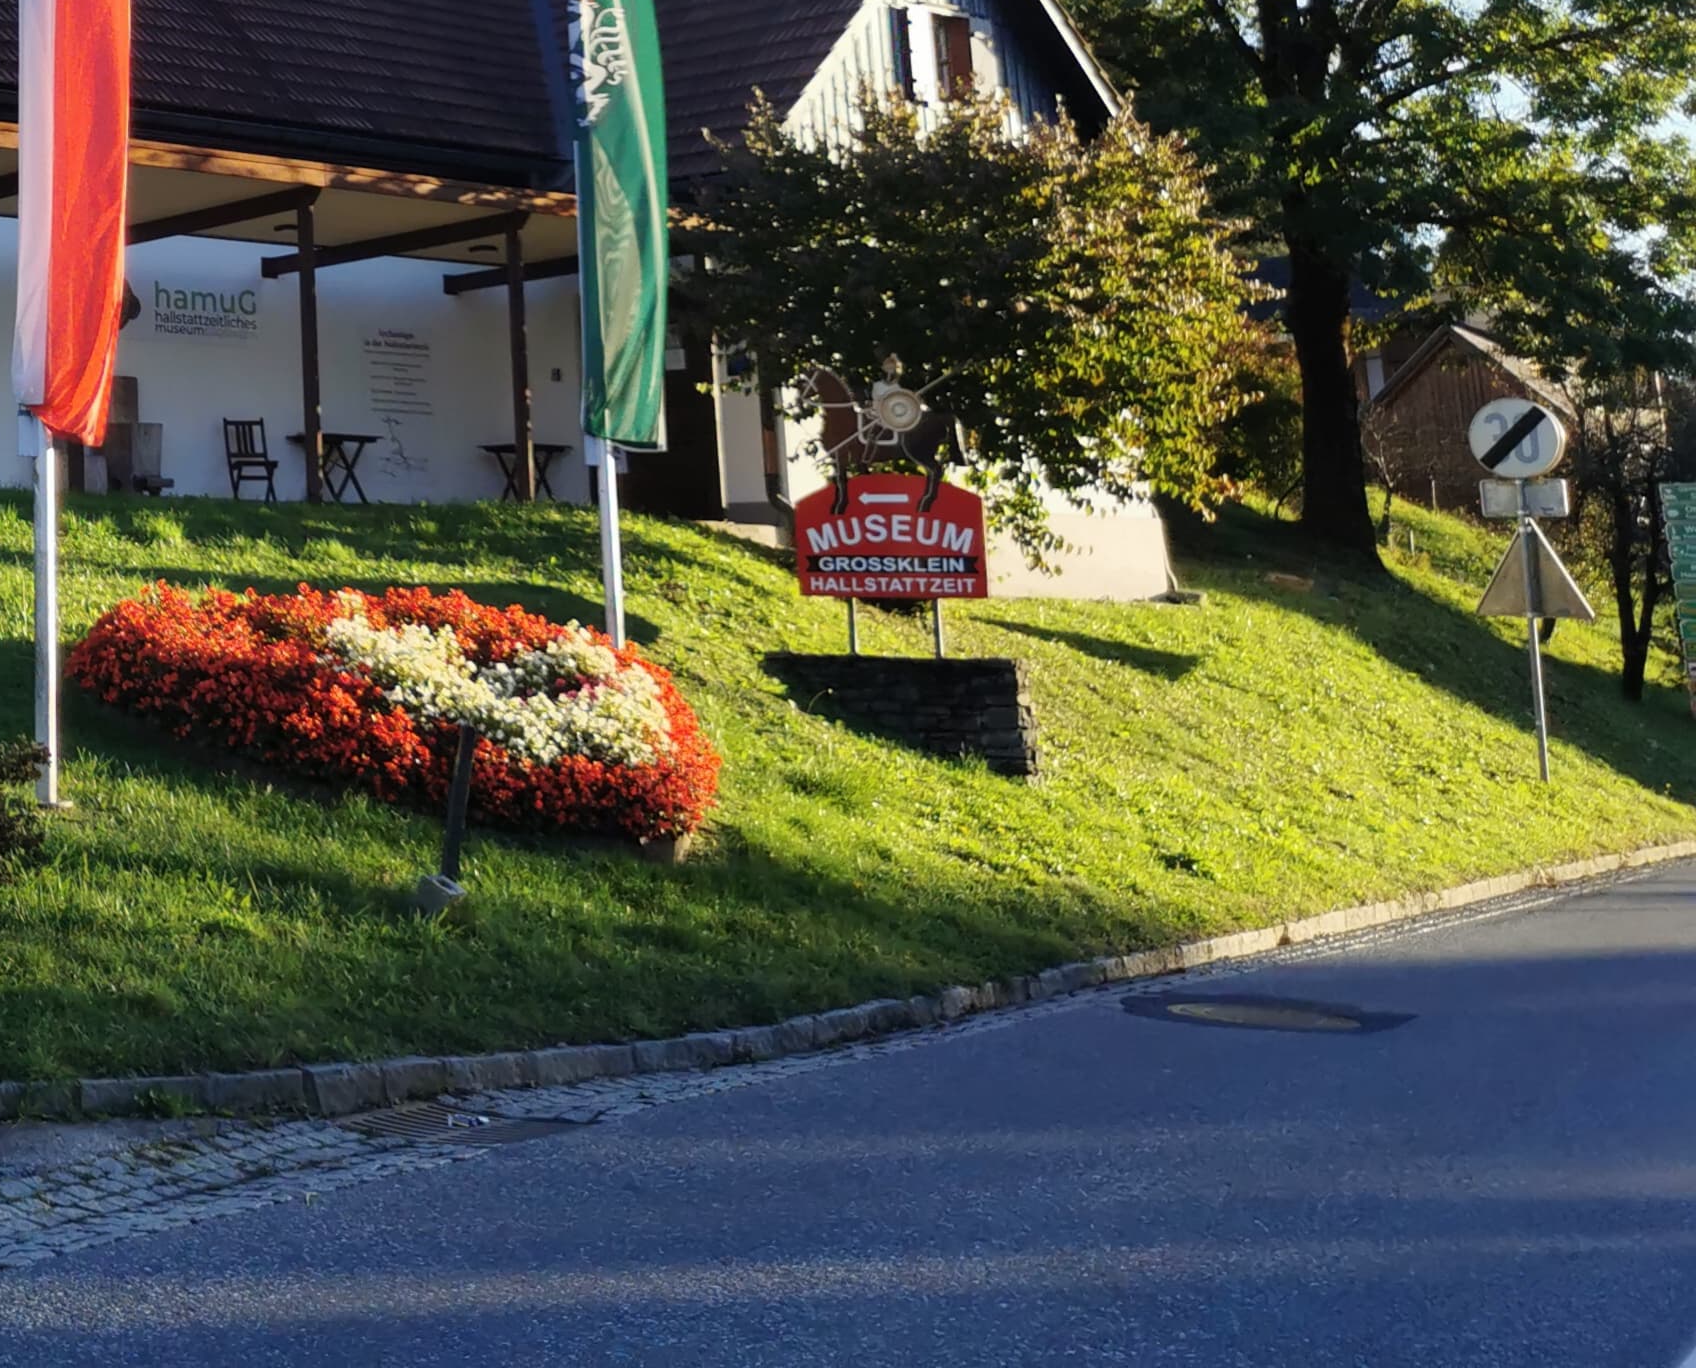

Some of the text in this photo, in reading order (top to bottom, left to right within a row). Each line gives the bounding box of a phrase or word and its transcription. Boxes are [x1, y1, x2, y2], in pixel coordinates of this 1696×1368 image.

[154, 280, 256, 315] hamuG
[154, 311, 257, 330] hallstattzeitliches
[806, 513, 974, 555] MUSEUM
[818, 556, 965, 572] GROSSKLEIN
[810, 576, 976, 593] HALLSTATTZEIT
